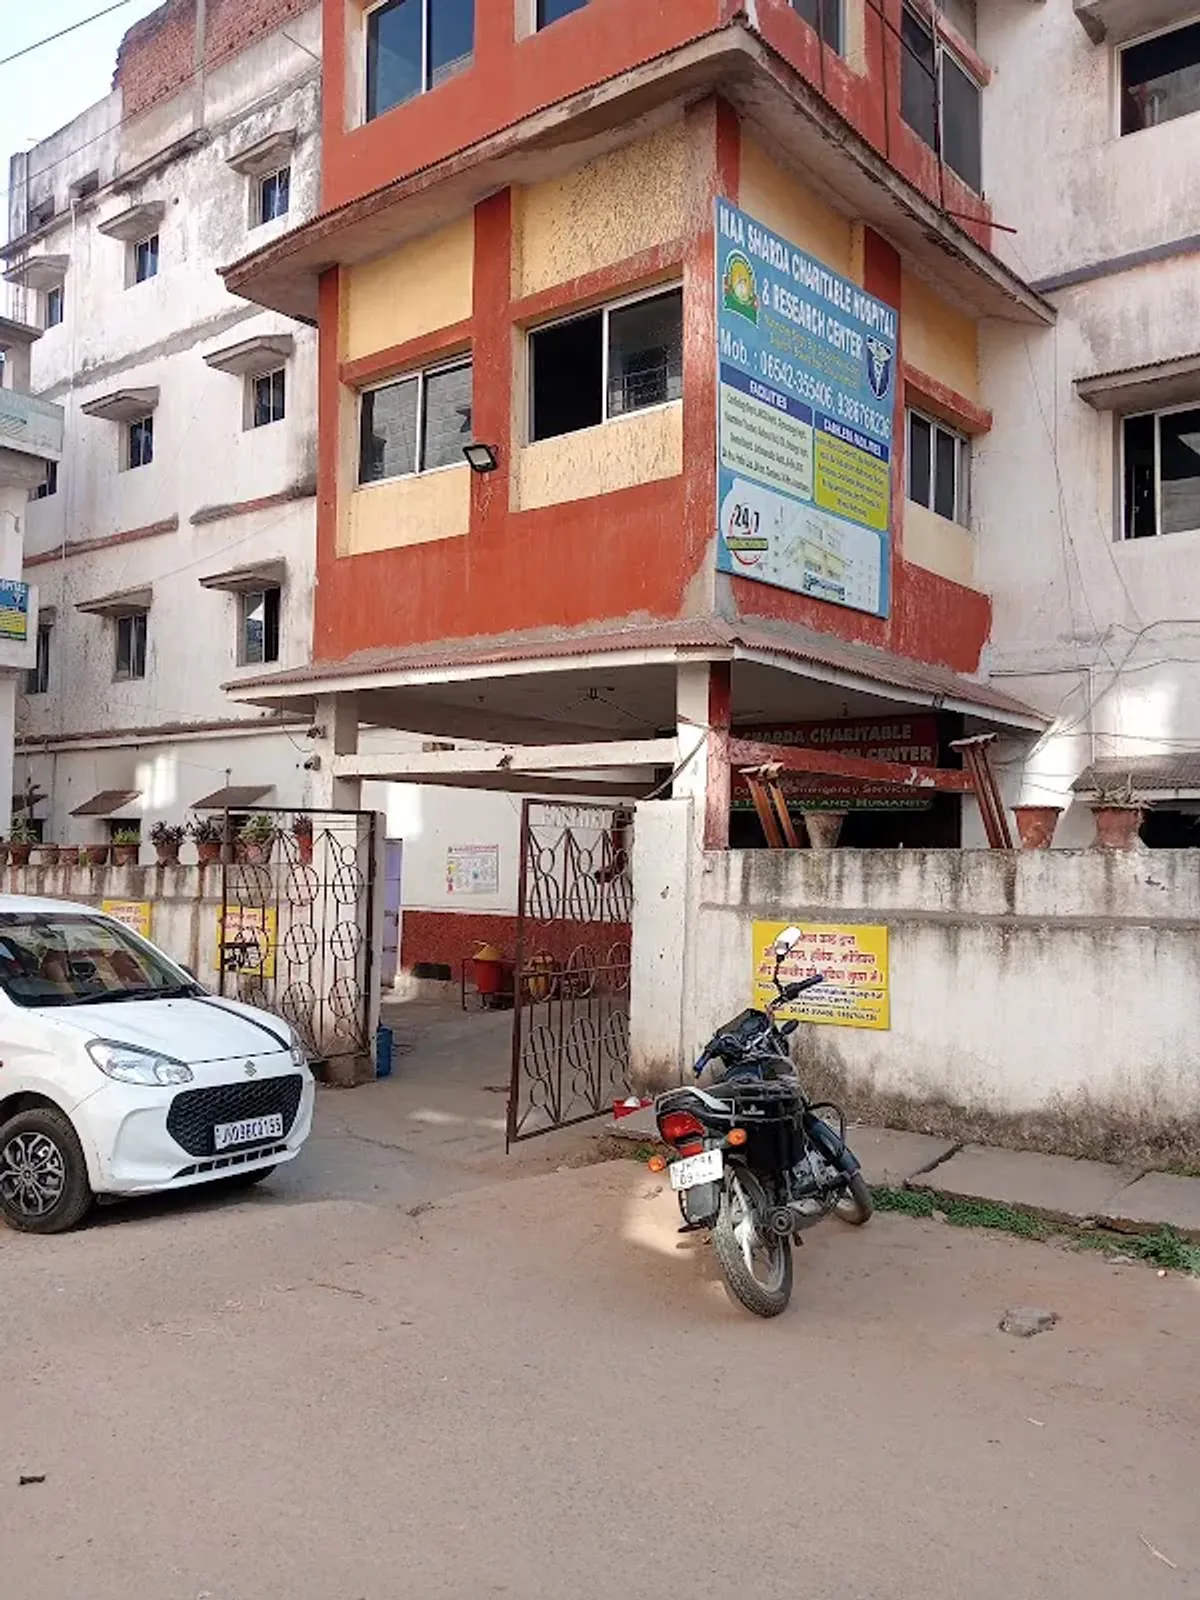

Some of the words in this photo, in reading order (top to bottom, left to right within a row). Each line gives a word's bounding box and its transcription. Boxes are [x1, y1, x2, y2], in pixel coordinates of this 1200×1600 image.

[748, 224, 790, 276] SHARDA
[791, 253, 851, 314] CHARITABLE
[854, 294, 896, 340] HOSPITAL
[761, 278, 770, 306] &
[773, 283, 825, 337] RESEARCH
[826, 315, 864, 362] CENTER
[750, 380, 787, 409] FACILITIES
[810, 724, 912, 743] CHARITABLE
